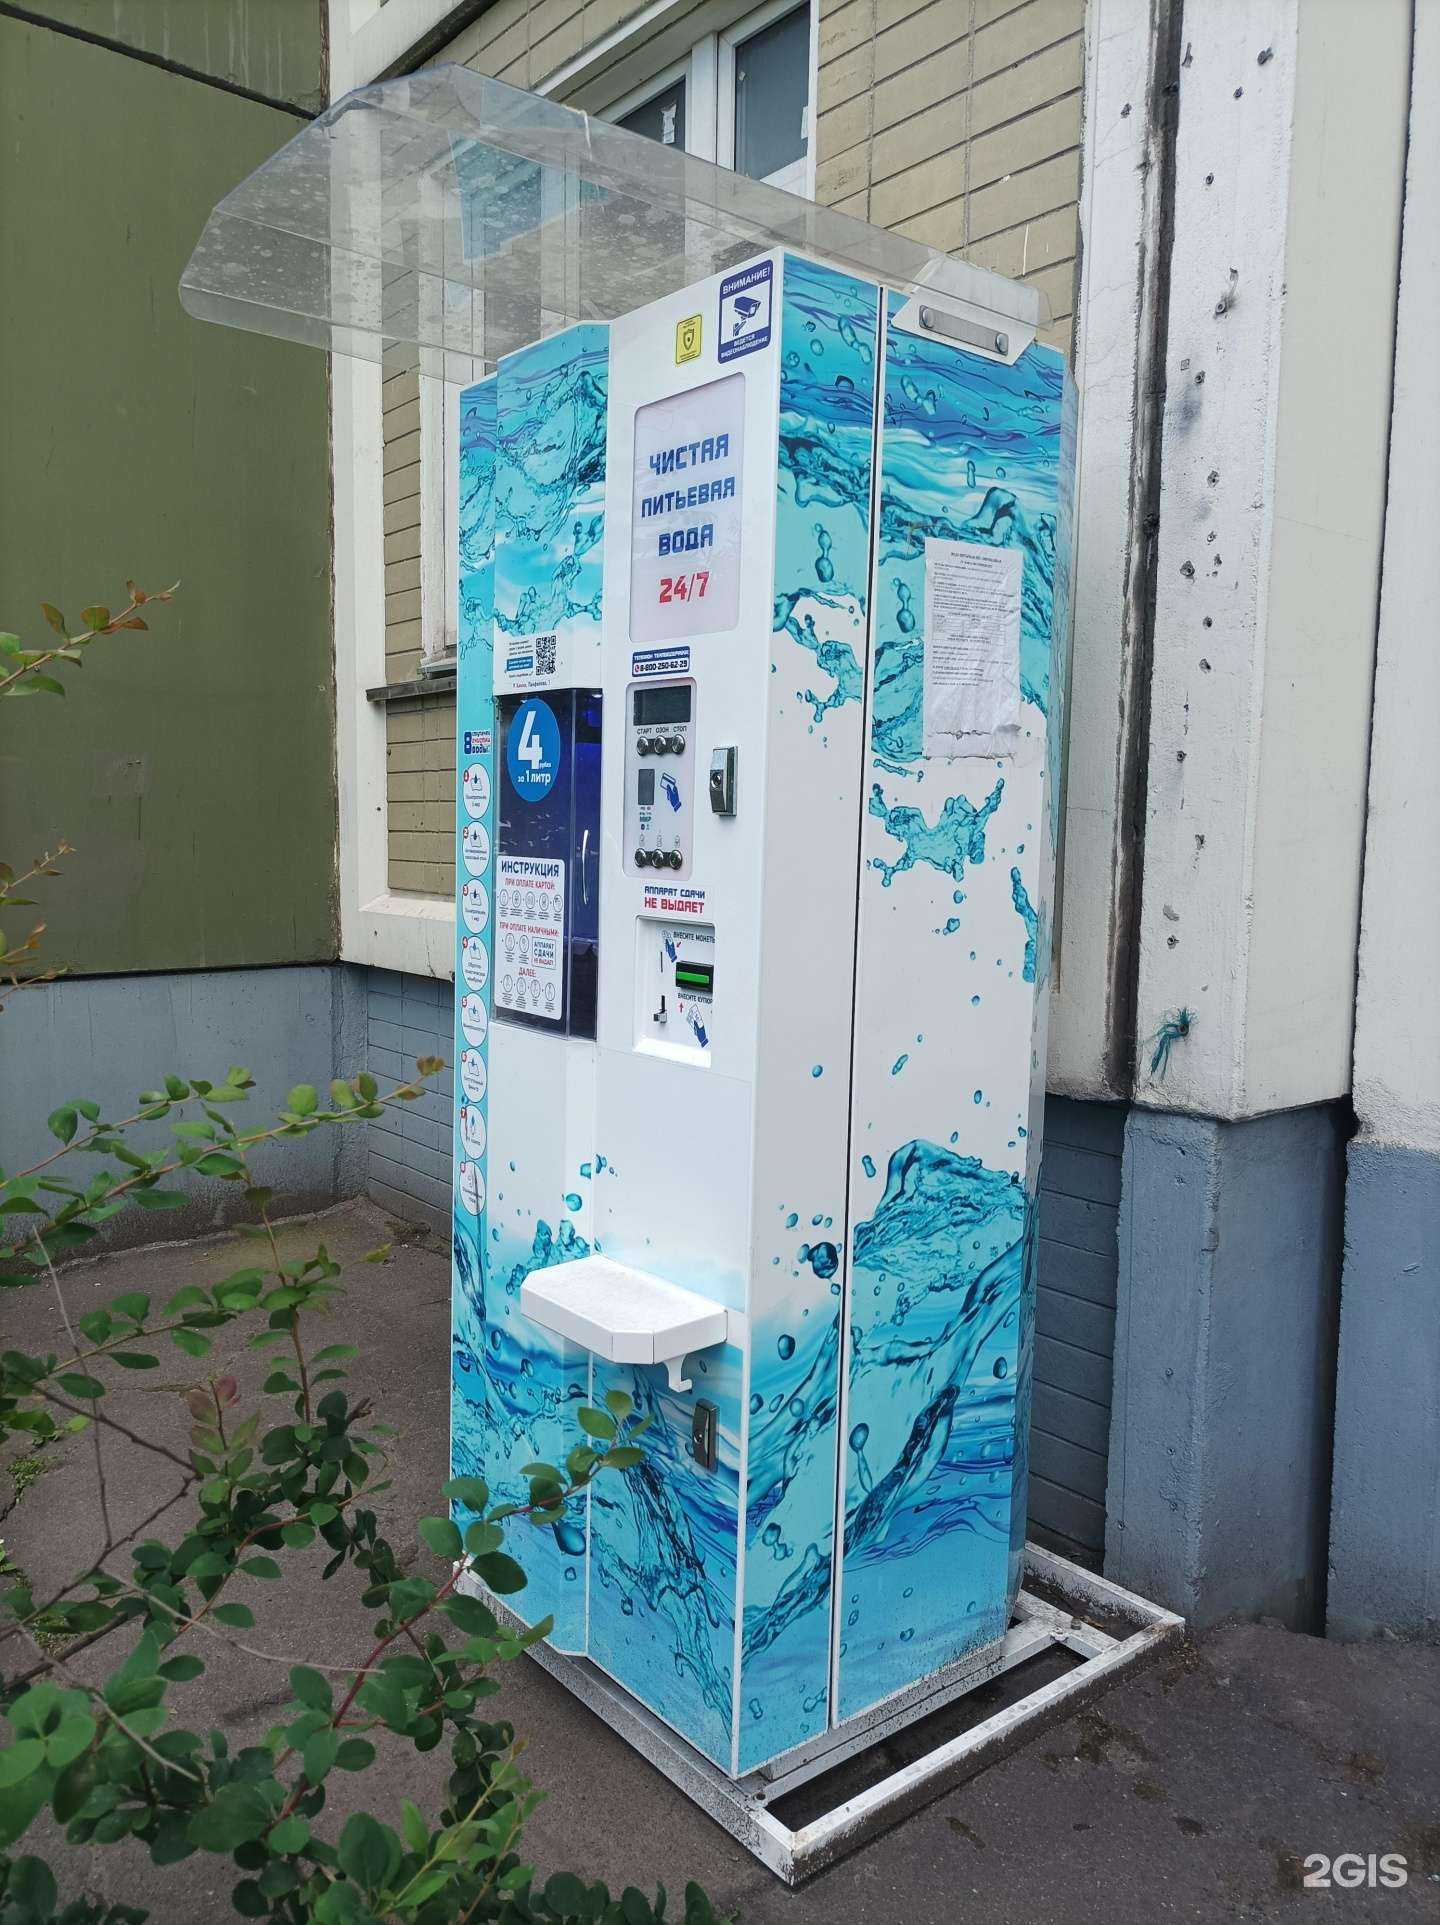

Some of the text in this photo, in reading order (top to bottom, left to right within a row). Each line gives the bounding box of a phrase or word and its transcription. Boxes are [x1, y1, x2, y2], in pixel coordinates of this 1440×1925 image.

[723, 266, 770, 294] ВНИМАНИЕ!
[649, 433, 729, 476] ЧИСТАЯ
[641, 476, 736, 518] ПИТЬЕВАЯ
[658, 523, 714, 557] ВОДА
[659, 571, 710, 604] 24/7
[637, 725, 687, 735] СТАРТ ОЗОН СТОП
[518, 711, 543, 769] 4
[517, 770, 551, 787] за 1 литр
[501, 860, 560, 878] ИНСТРУКЦИЯ
[645, 886, 705, 899] АППАРАТ СДАЧИ
[645, 897, 704, 913] НЕ ВЫДАЕТ
[673, 931, 694, 941] ВНЕСИТЕ
[534, 949, 554, 959] СДАЧИ
[677, 992, 697, 1001] ВНЕСИТЕ
